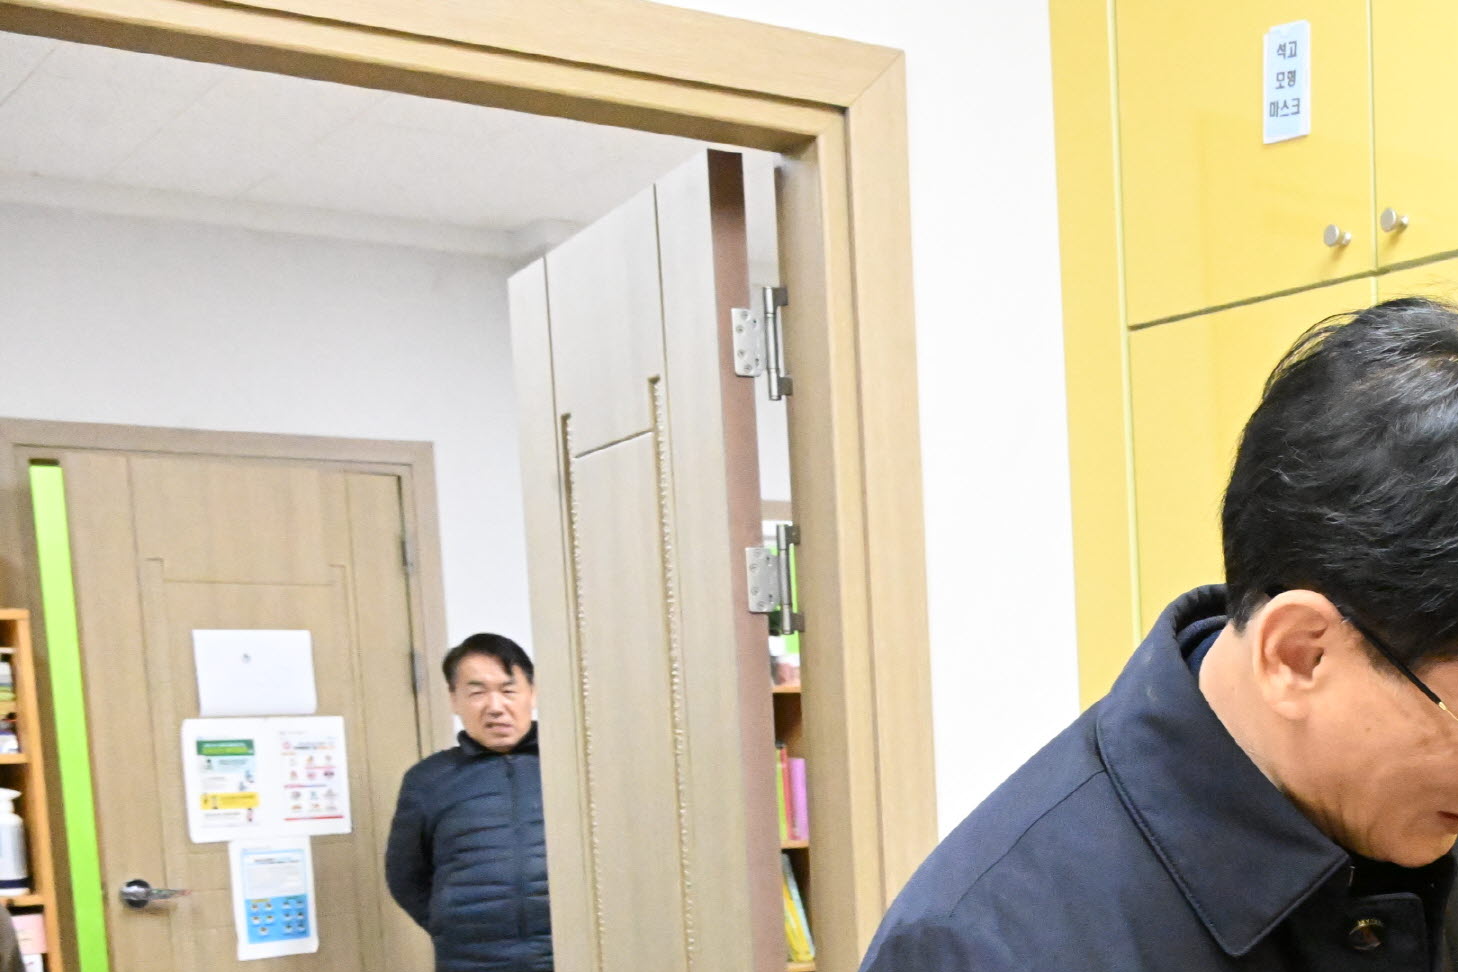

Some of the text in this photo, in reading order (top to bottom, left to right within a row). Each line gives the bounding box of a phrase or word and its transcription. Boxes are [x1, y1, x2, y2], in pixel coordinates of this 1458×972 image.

[1276, 40, 1298, 60] 석고
[1275, 69, 1297, 90] 모형
[1269, 97, 1301, 118] 마스크
